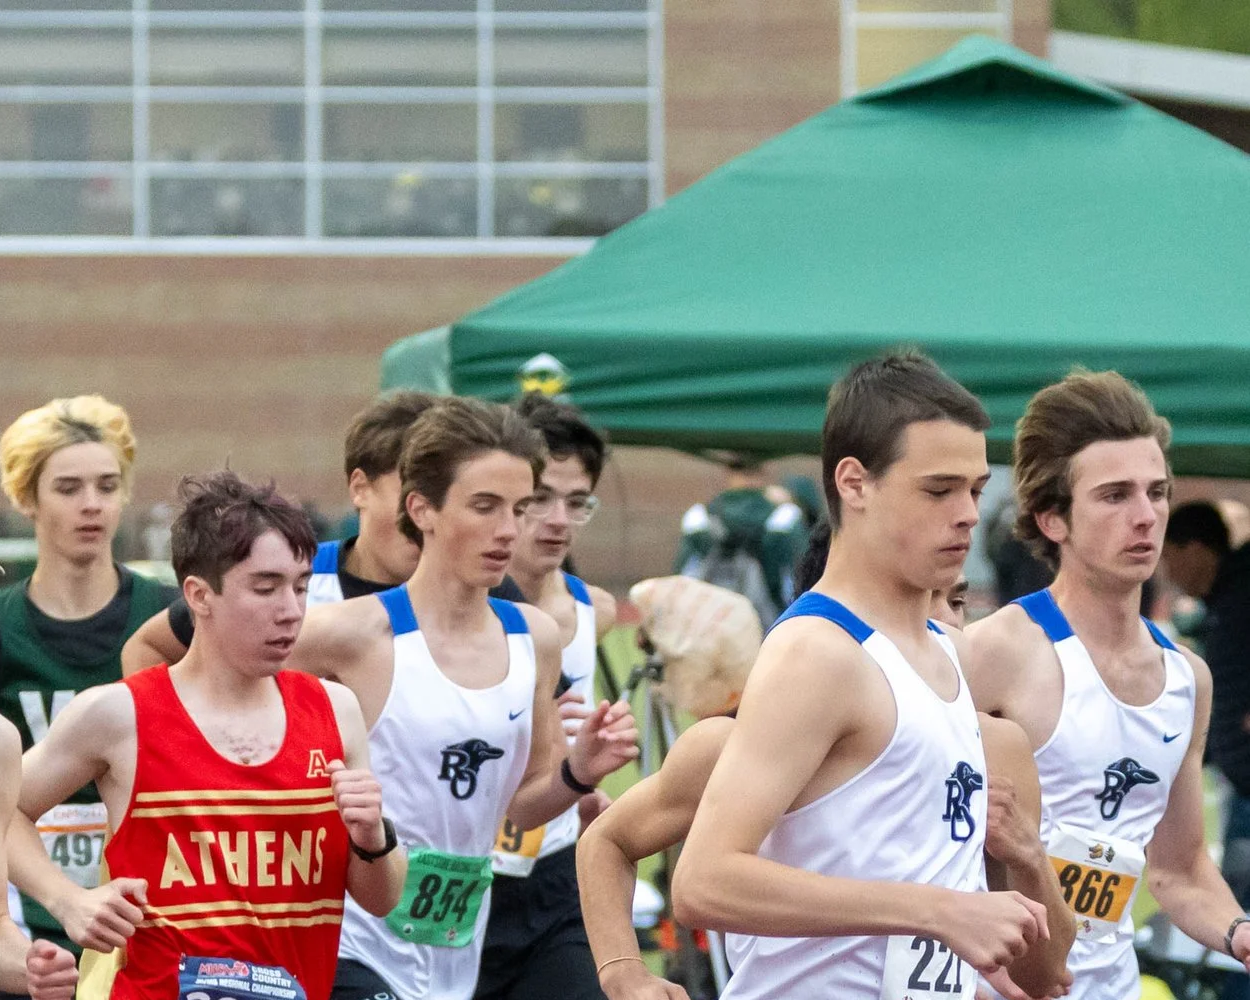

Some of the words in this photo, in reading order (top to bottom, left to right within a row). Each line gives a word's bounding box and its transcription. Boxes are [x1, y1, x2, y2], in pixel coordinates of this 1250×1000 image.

[306, 749, 331, 778] A
[159, 826, 327, 889] ATHENS
[409, 873, 480, 923] 854
[1059, 863, 1121, 918] 866
[251, 966, 282, 978] CROSS
[251, 973, 292, 988] COUNTRY
